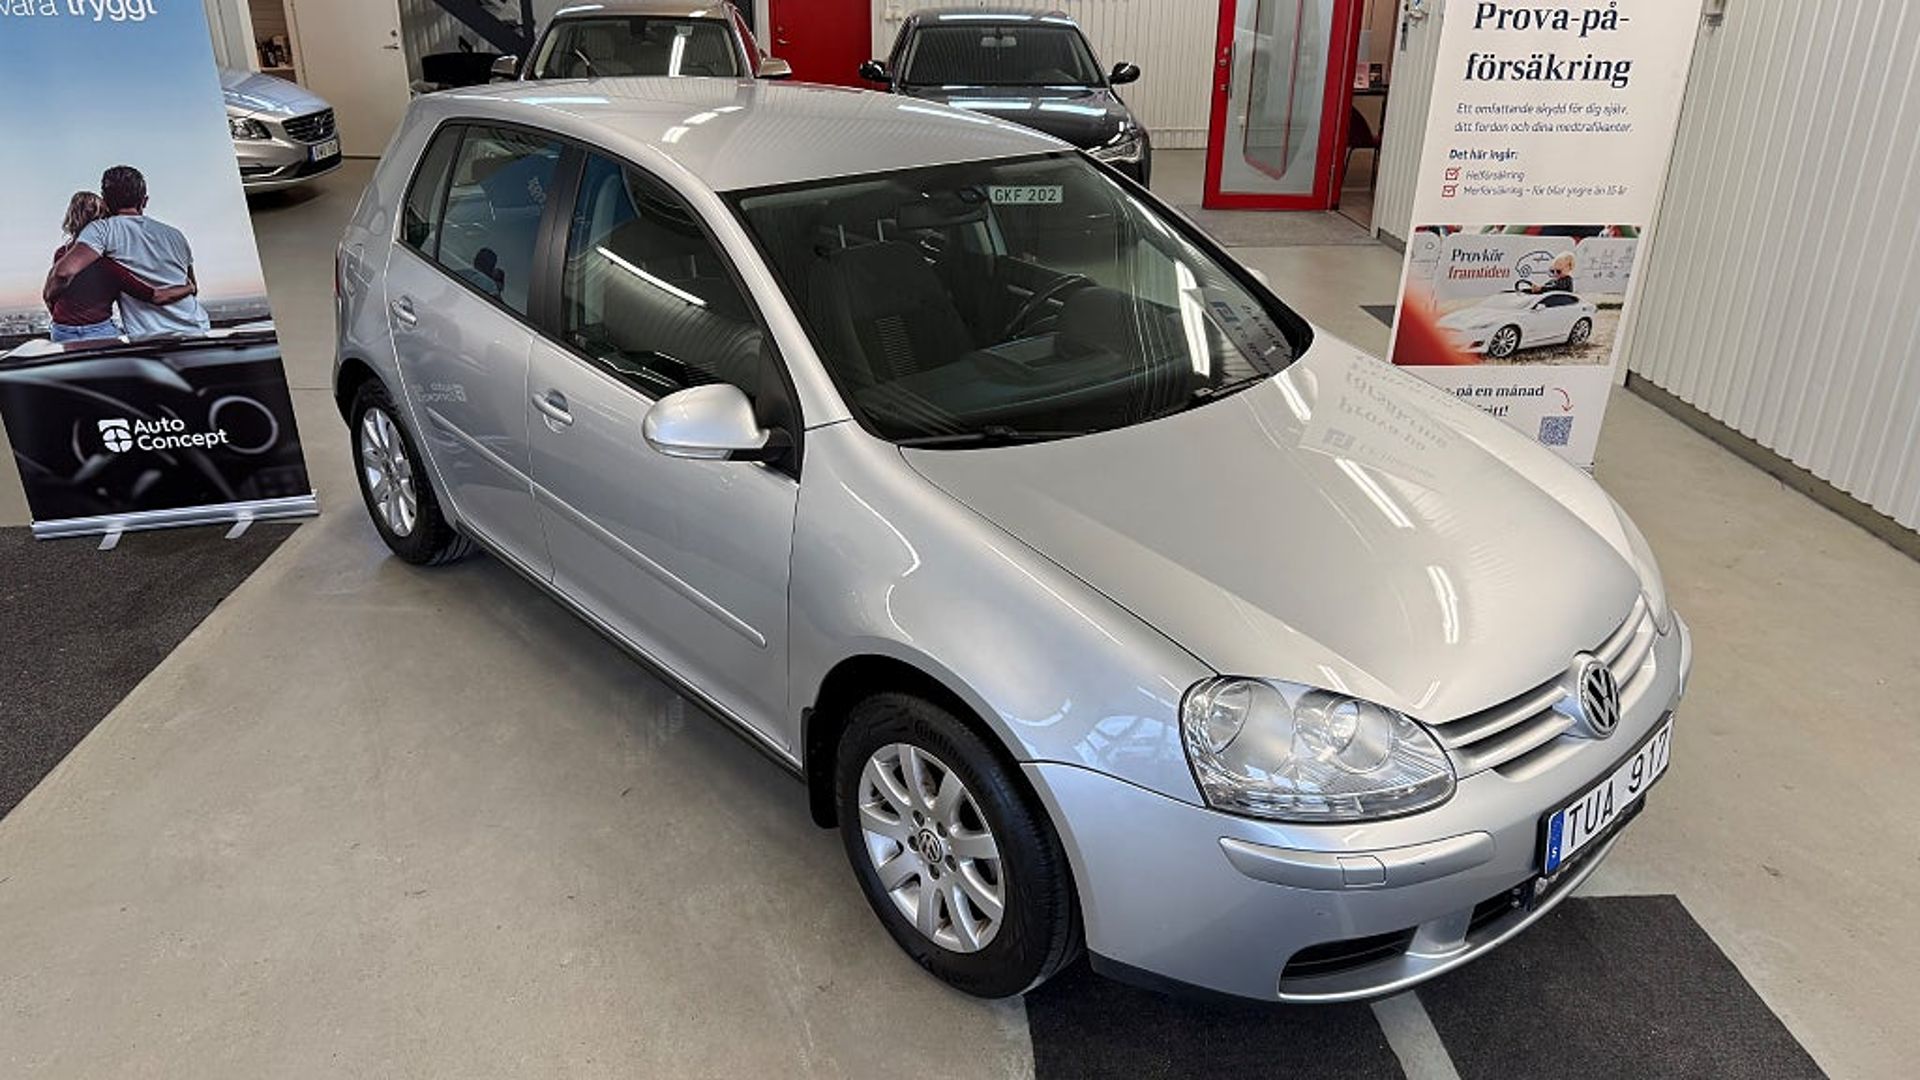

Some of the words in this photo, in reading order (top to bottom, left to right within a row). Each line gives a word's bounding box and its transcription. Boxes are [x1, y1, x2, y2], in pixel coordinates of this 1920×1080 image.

[67, 0, 158, 21] tryggt
[1473, 2, 1630, 38] Prova-på-
[1464, 53, 1633, 88] försäkring
[1457, 102, 1472, 114] Ett
[1475, 102, 1533, 114] omfattande
[1536, 102, 1566, 117] skydd
[1568, 102, 1583, 114] för
[1586, 102, 1601, 116] dig
[1455, 122, 1472, 132] ditt
[1474, 121, 1509, 132] fordon
[1511, 121, 1529, 132] och
[1532, 121, 1553, 132] dina
[1449, 149, 1468, 160] Det
[1470, 148, 1488, 160] här
[1490, 147, 1518, 162] ingår:
[994, 188, 1024, 201] GKF
[1027, 188, 1057, 201] 202
[1451, 248, 1504, 262] Provkör
[1448, 265, 1511, 280] framtiden
[1475, 386, 1493, 397] en
[1495, 383, 1546, 397] månad
[134, 416, 185, 435] Auto
[137, 428, 229, 451] Concept
[1569, 779, 1615, 847] TUA
[1628, 726, 1670, 794] 917
